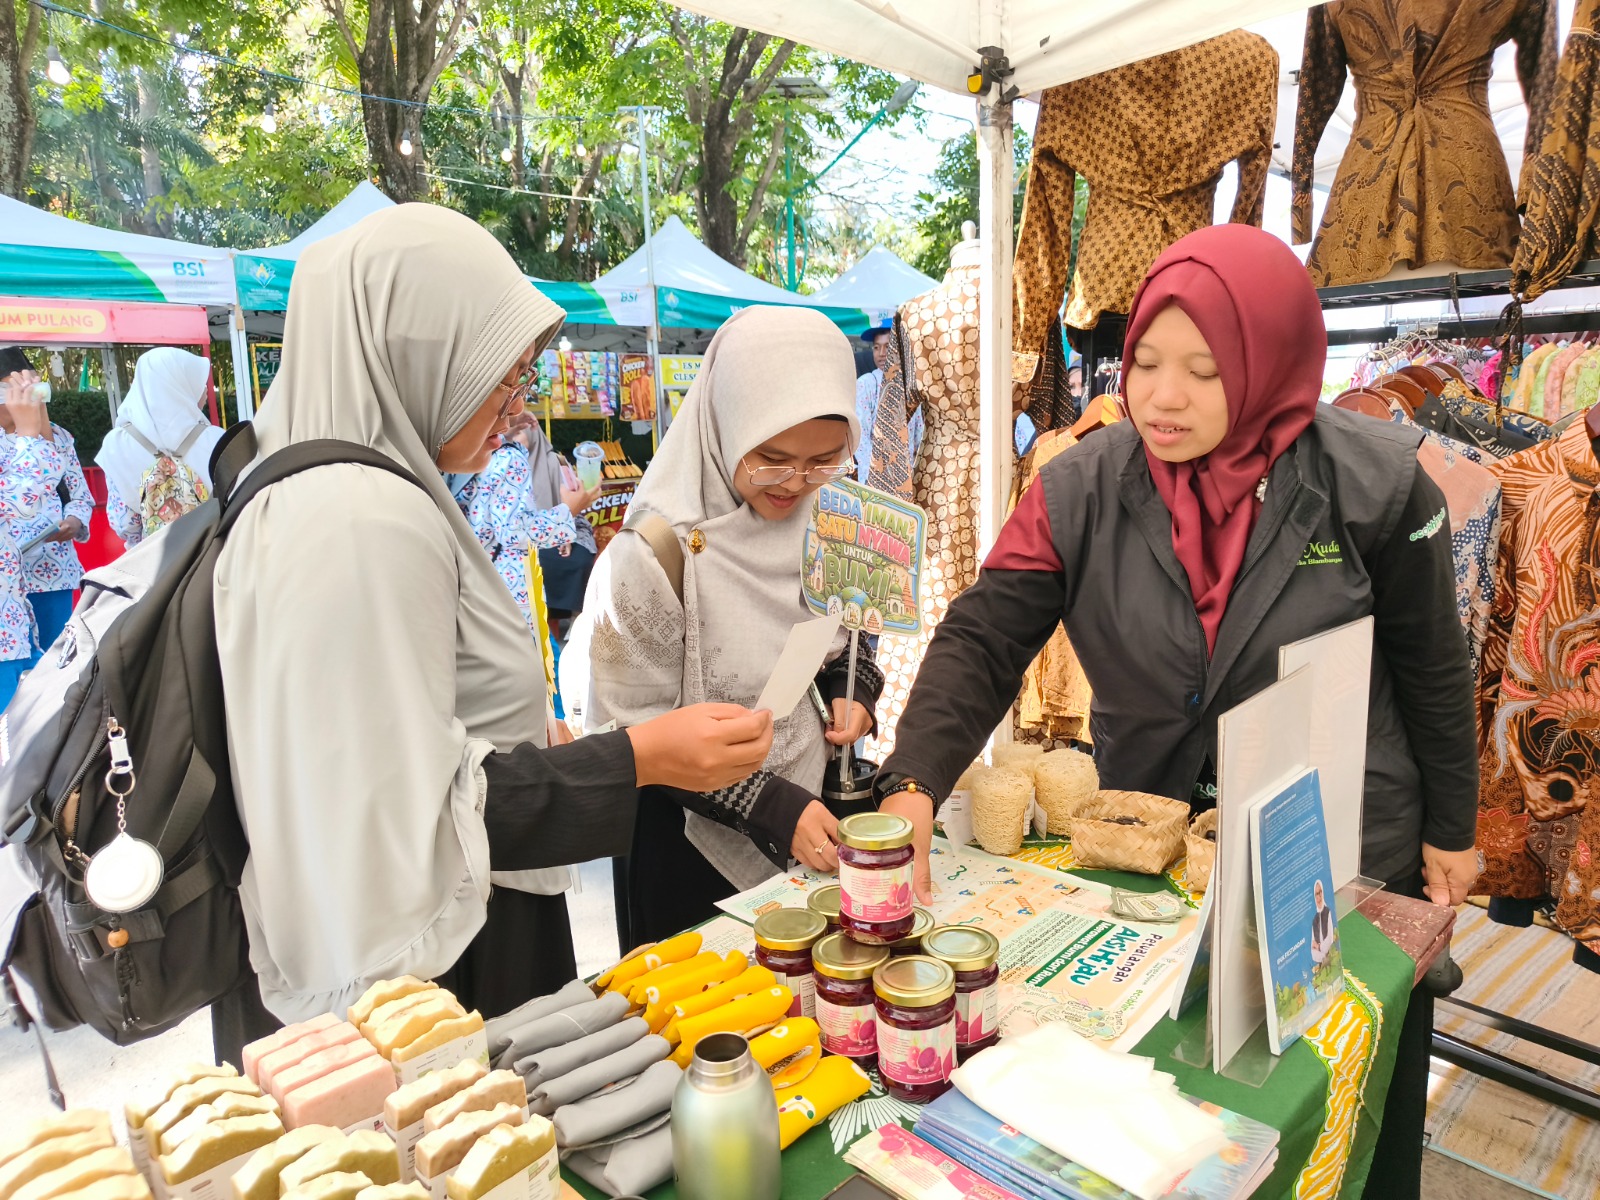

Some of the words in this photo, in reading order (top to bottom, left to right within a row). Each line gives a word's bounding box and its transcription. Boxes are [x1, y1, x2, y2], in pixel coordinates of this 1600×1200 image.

[173, 261, 206, 277] BSI
[620, 291, 638, 302] BSI
[27, 313, 94, 328] PULANG
[623, 368, 642, 385] ROLL
[818, 487, 863, 521] BEDA
[585, 506, 623, 528] OLL
[816, 513, 857, 543] SATU
[857, 525, 911, 567] NYAWA
[1303, 540, 1340, 559] Muda
[843, 544, 874, 564] UNTUK
[824, 553, 892, 601] BUMI
[1081, 920, 1113, 946] Merawat
[1100, 926, 1141, 952] Aksi
[1061, 941, 1085, 960] Bumi
[1111, 933, 1164, 983] Petualangan
[1048, 956, 1067, 973] dari
[1070, 948, 1120, 986] Hijau
[1029, 968, 1054, 986] Rum
